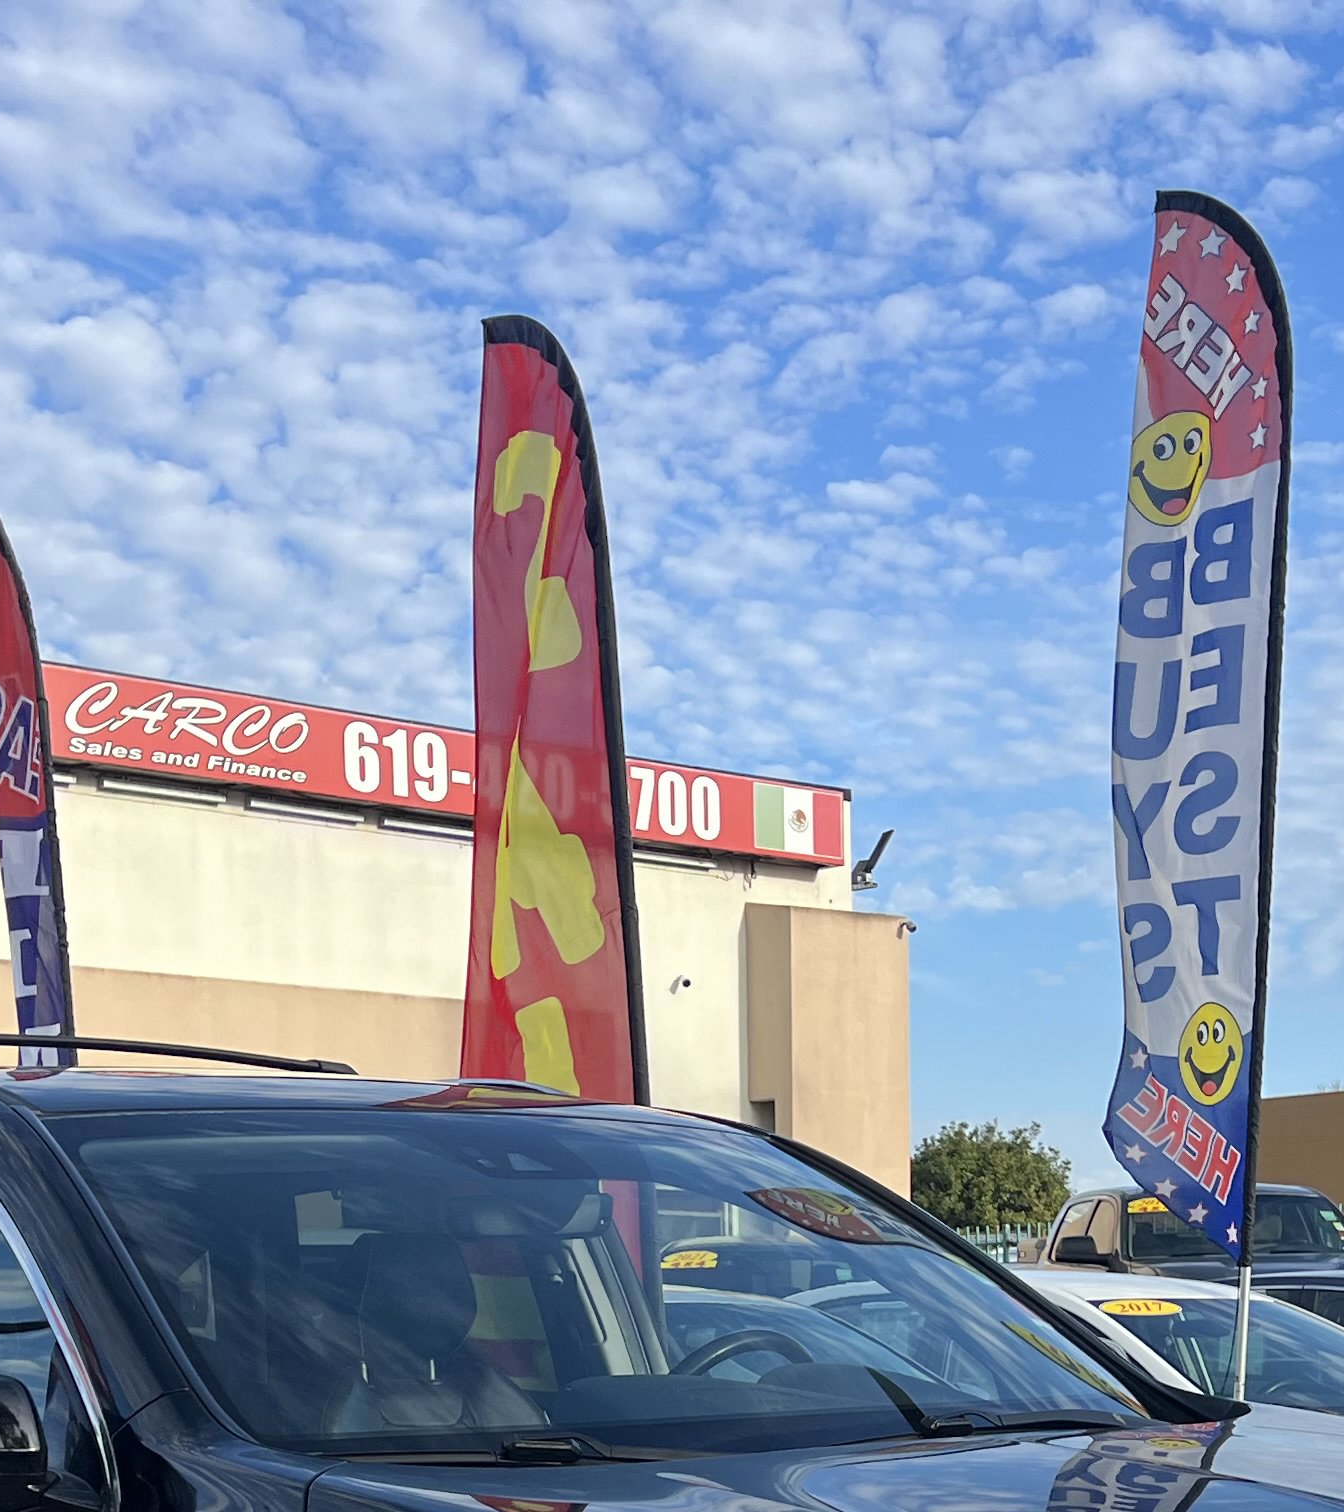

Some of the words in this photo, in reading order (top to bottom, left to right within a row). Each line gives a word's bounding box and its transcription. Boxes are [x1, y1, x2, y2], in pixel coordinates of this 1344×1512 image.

[65, 681, 310, 756] CARCO
[69, 737, 142, 761] Sales
[151, 750, 199, 769] and
[207, 756, 308, 784] Finance
[1115, 1301, 1163, 1313] 2017
